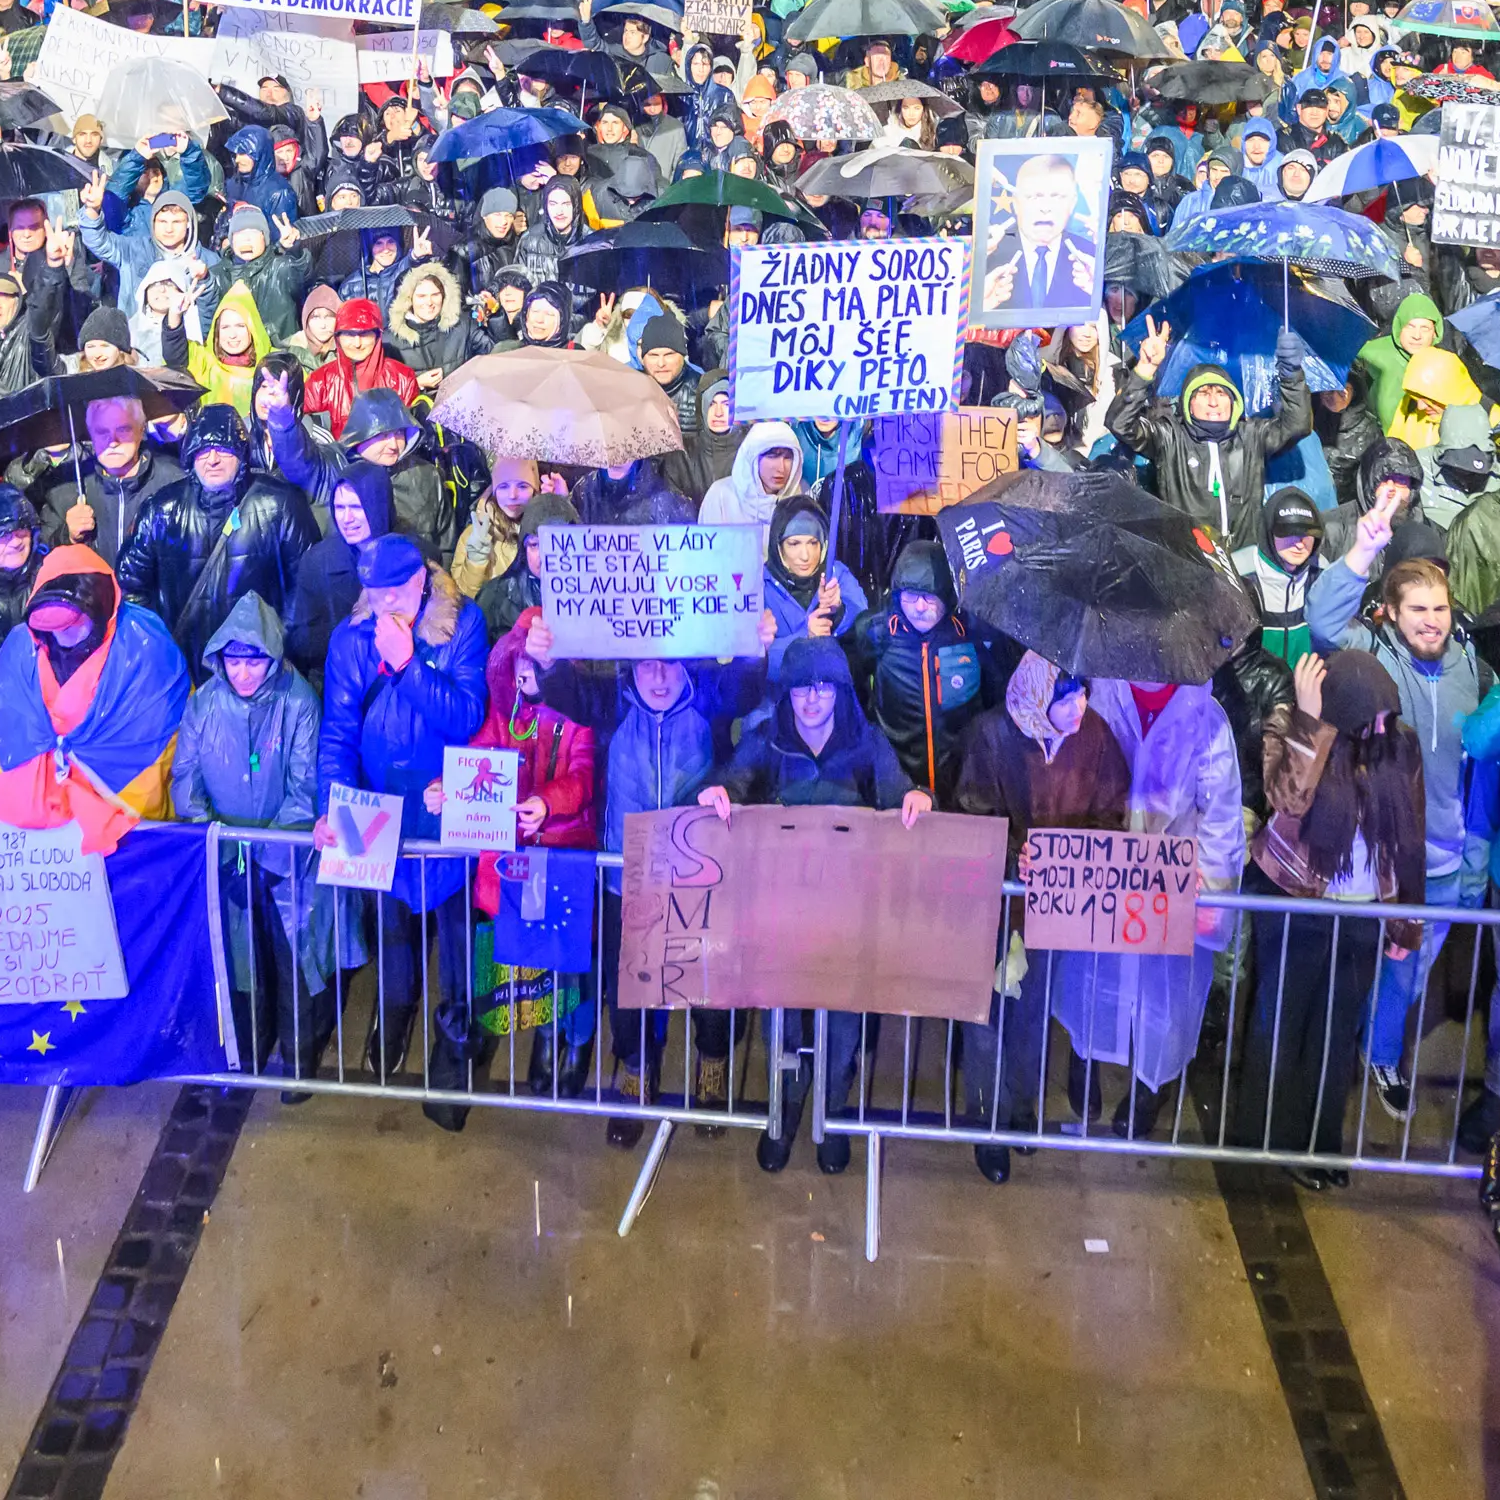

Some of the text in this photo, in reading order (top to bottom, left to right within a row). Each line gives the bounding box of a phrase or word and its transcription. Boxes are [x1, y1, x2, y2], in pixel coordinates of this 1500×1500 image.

[372, 36, 395, 50] MY
[39, 61, 96, 91] NIKDY
[759, 247, 957, 288] ŽIADNY SOROS.
[740, 281, 955, 325] DNES MA PLATÍ
[769, 318, 913, 358] MÔJ ŠÉF.
[772, 351, 930, 394] DÍKY PEŤO.
[833, 386, 949, 416] (NIE TEN)
[880, 412, 1012, 450] FIRST THEY
[877, 447, 1011, 482] CAME FOR
[1278, 507, 1313, 518] GARMIN
[551, 526, 719, 553] NA ÚRADE VLÁDY
[954, 515, 990, 571] PARIS
[544, 550, 670, 575] EŠTE STÁLE
[550, 572, 719, 595] OSLAVUJÚ VOSR
[556, 593, 759, 618] MY ALE VIEME KDE JE
[606, 615, 682, 639] "SEVER"
[465, 811, 491, 823] nám
[447, 828, 509, 843] nesiahaj!!!
[1028, 832, 1195, 868] STOJIM TU AKO
[20, 871, 93, 893] SLOBODA
[1027, 864, 1191, 894] MOJI RODIČIA V
[1026, 890, 1170, 945] ROKU 1989
[4, 949, 60, 972] SI JU
